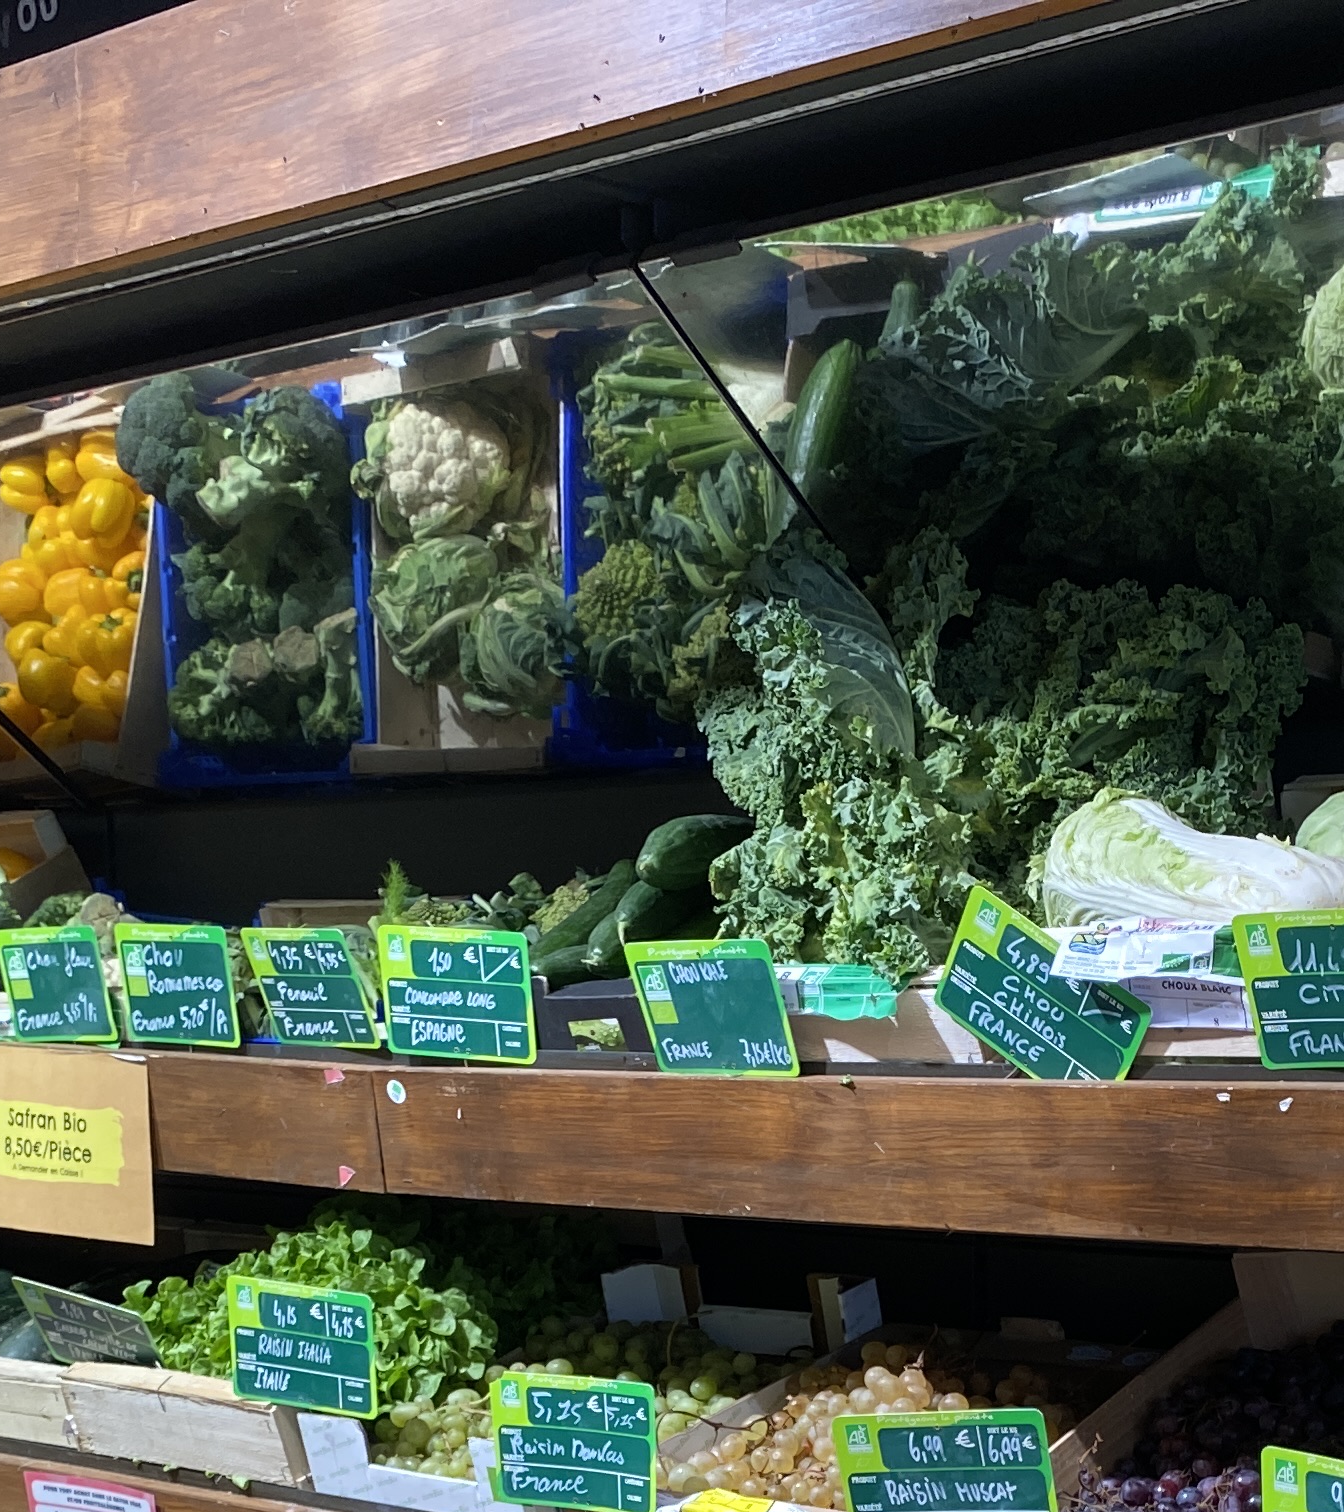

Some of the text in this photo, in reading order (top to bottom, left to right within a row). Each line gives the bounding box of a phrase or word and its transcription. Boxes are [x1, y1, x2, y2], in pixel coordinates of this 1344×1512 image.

[668, 960, 727, 985] CHOU KALE
[1003, 936, 1051, 984] 4,89
[278, 984, 327, 1002] Fenouil
[1002, 976, 1065, 1023] CHOU
[1162, 980, 1231, 995] CHOUX BLANC
[467, 994, 496, 1011] LONG
[284, 1017, 339, 1037] France
[994, 991, 1061, 1049] CHINOIS
[411, 1022, 466, 1047] ESPAGNE
[968, 1004, 1046, 1063] FRANCE
[662, 1038, 712, 1060] FRANCE
[7, 1107, 87, 1133] Safran Bio
[4, 1135, 92, 1164] 8,50€/Pièce
[258, 1336, 331, 1366] RAISIN ITALIA
[510, 1434, 568, 1459] Raisin
[907, 1433, 944, 1465] 6,99
[511, 1472, 588, 1496] France
[886, 1477, 1016, 1506] RAISIN MUSCAT
